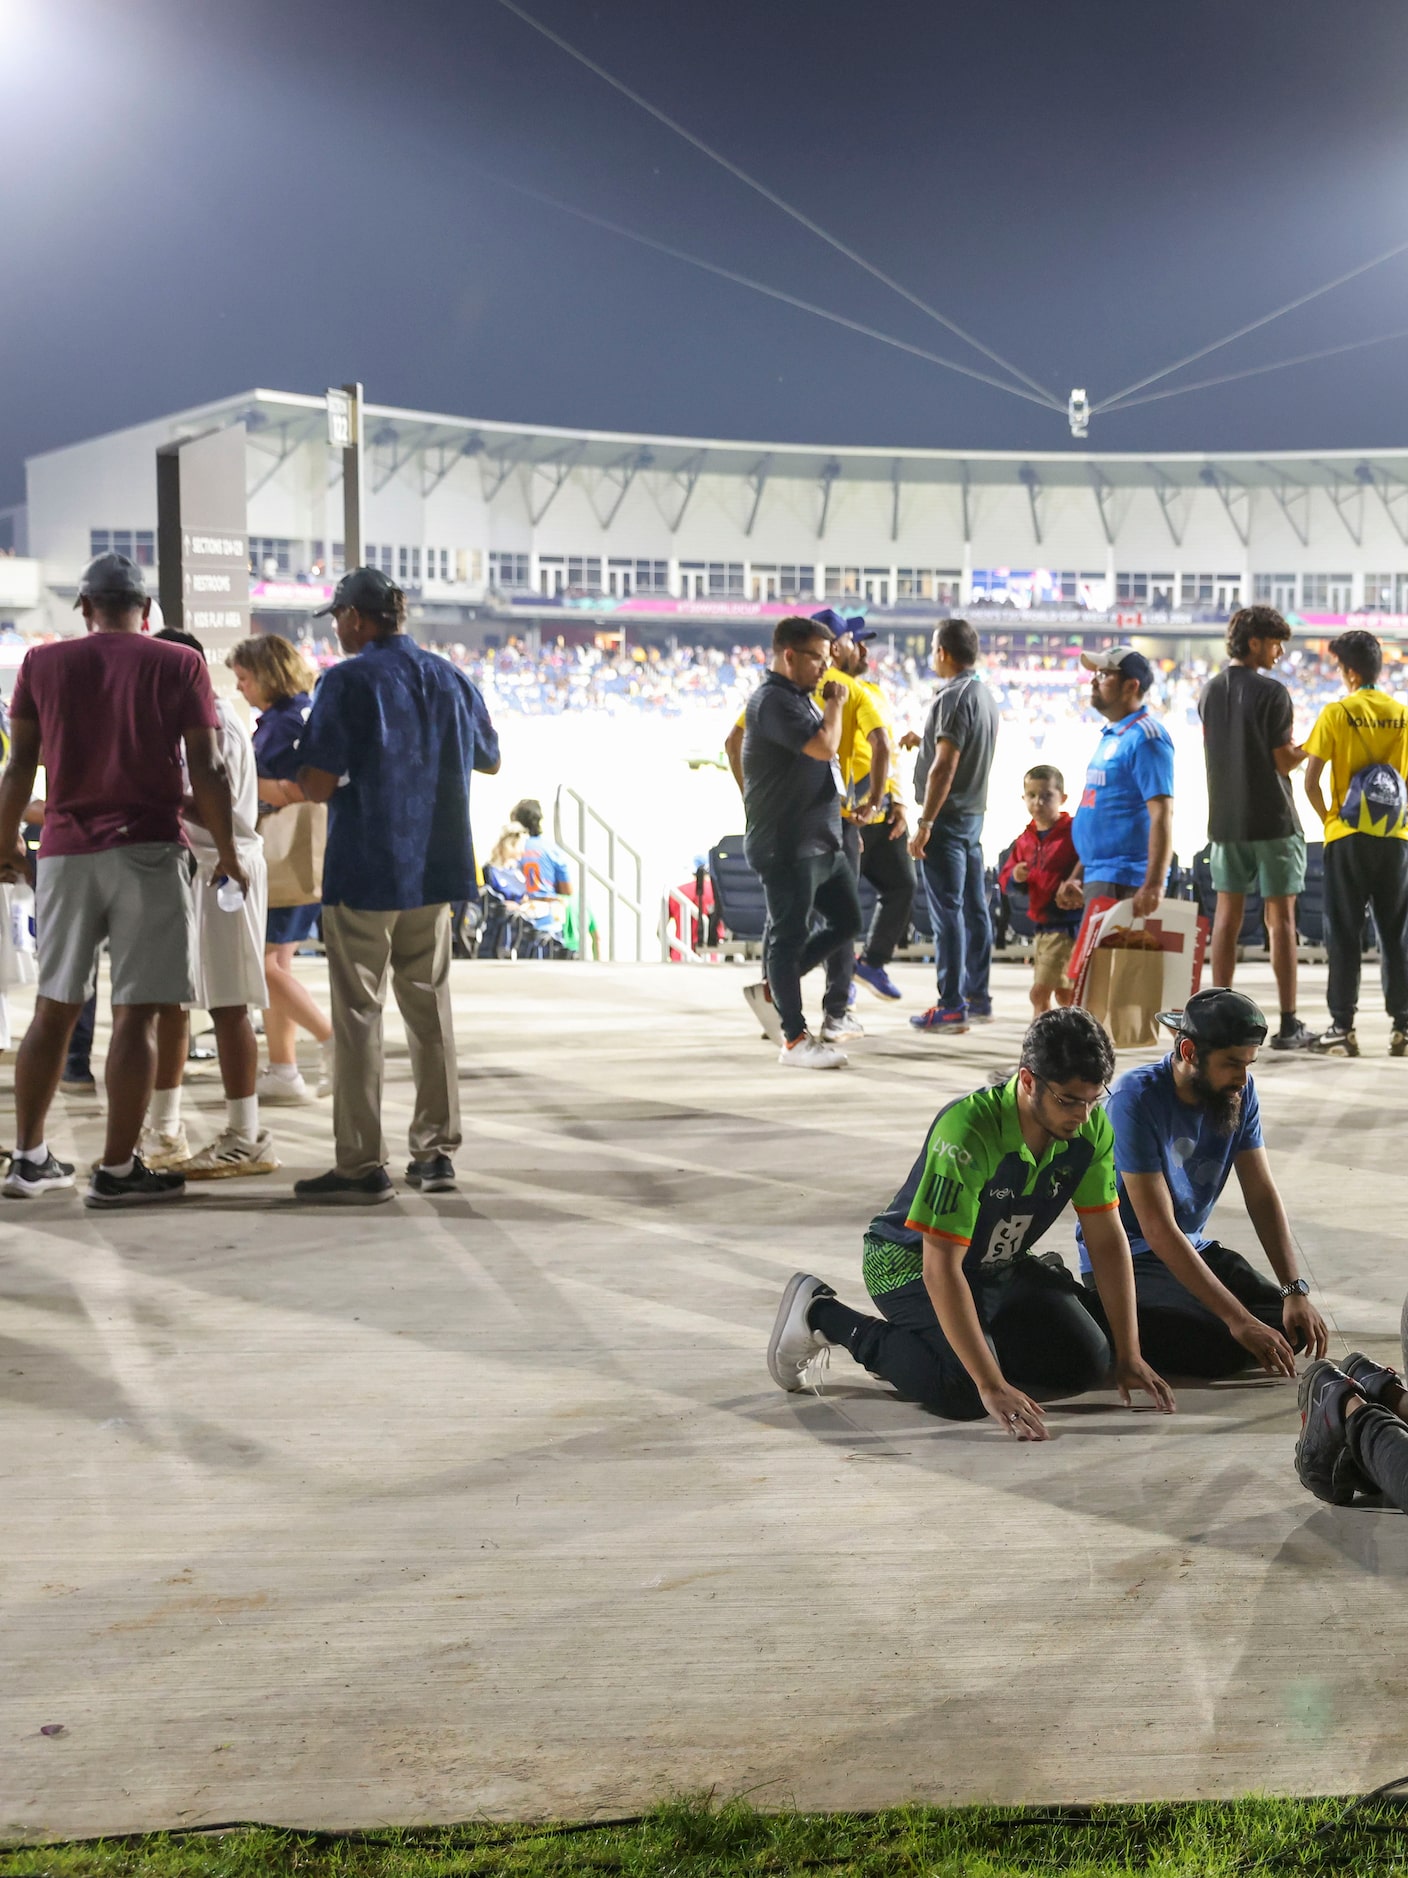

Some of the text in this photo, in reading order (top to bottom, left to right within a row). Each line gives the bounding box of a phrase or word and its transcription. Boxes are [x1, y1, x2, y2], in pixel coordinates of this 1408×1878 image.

[192, 574, 231, 592] RESTROOMS
[209, 611, 225, 629] PLAY
[225, 611, 242, 629] AREA
[1021, 611, 1058, 622] WORLD
[1059, 612, 1080, 622] CUP
[1346, 716, 1407, 729] VOLUNTEE
